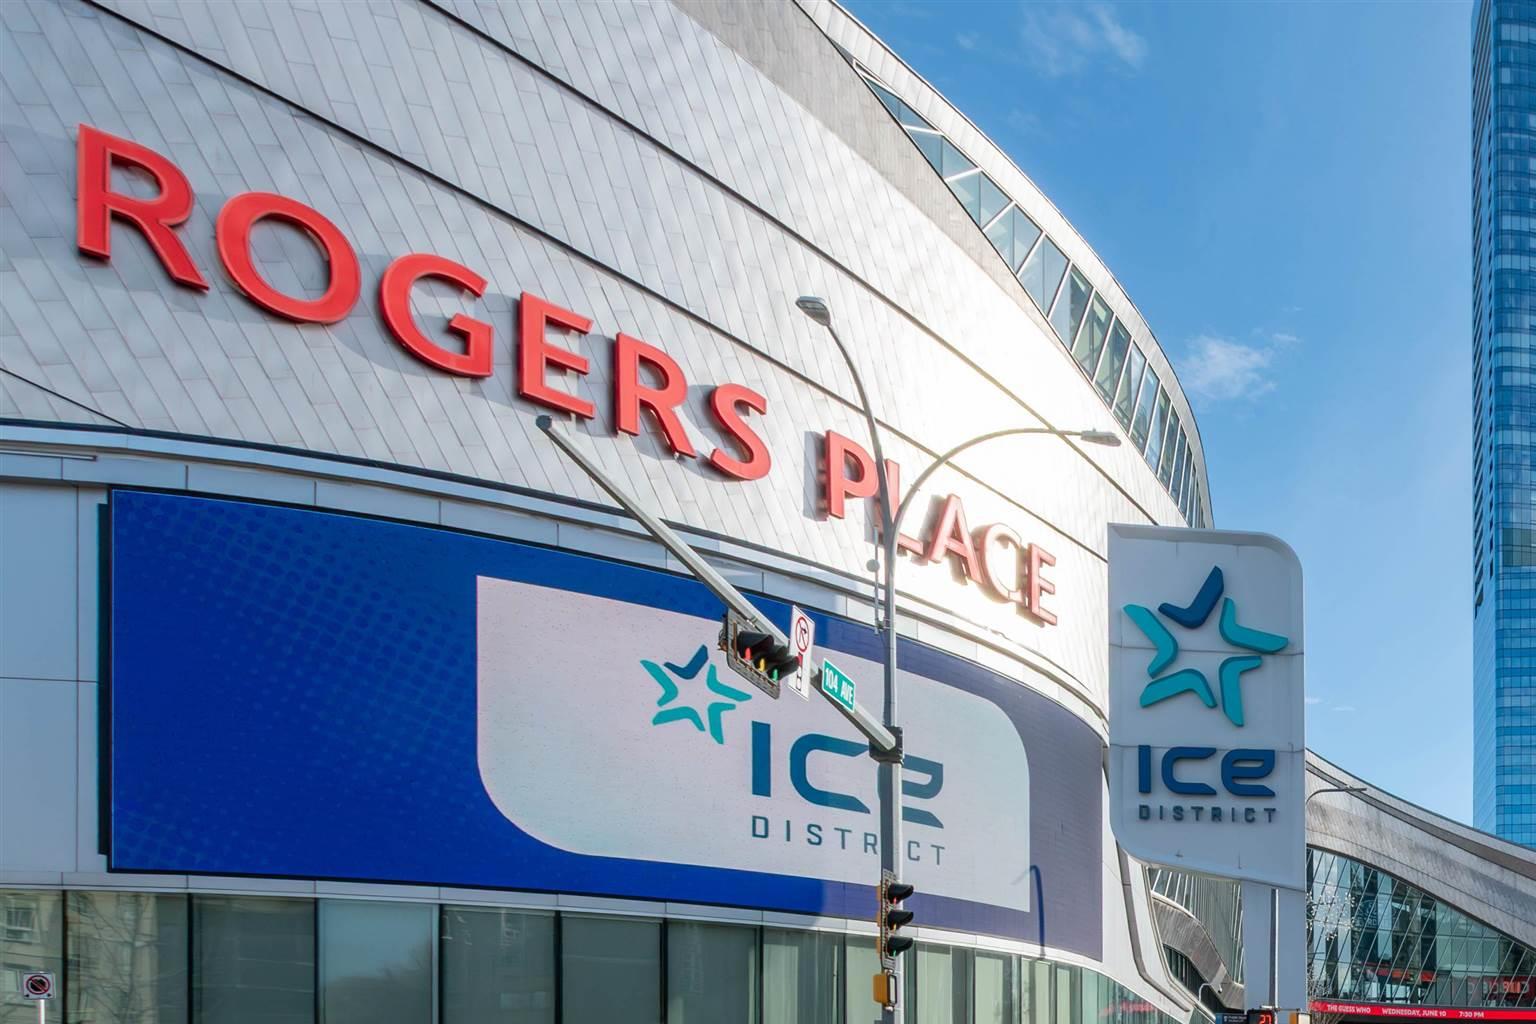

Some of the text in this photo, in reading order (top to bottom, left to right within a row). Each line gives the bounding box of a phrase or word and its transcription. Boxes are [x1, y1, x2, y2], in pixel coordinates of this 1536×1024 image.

[77, 123, 1058, 626] ROGERS PLACE
[825, 667, 854, 705] 104 AVE
[1138, 804, 1277, 823] DISTRICT
[752, 815, 945, 866] DISTRCT
[1327, 1004, 1337, 1012] THE
[1338, 1005, 1355, 1013] GUESS
[1355, 1006, 1371, 1014] WHO
[1382, 1008, 1421, 1017] WEDNESDAY,
[1422, 1009, 1438, 1017] JUNE
